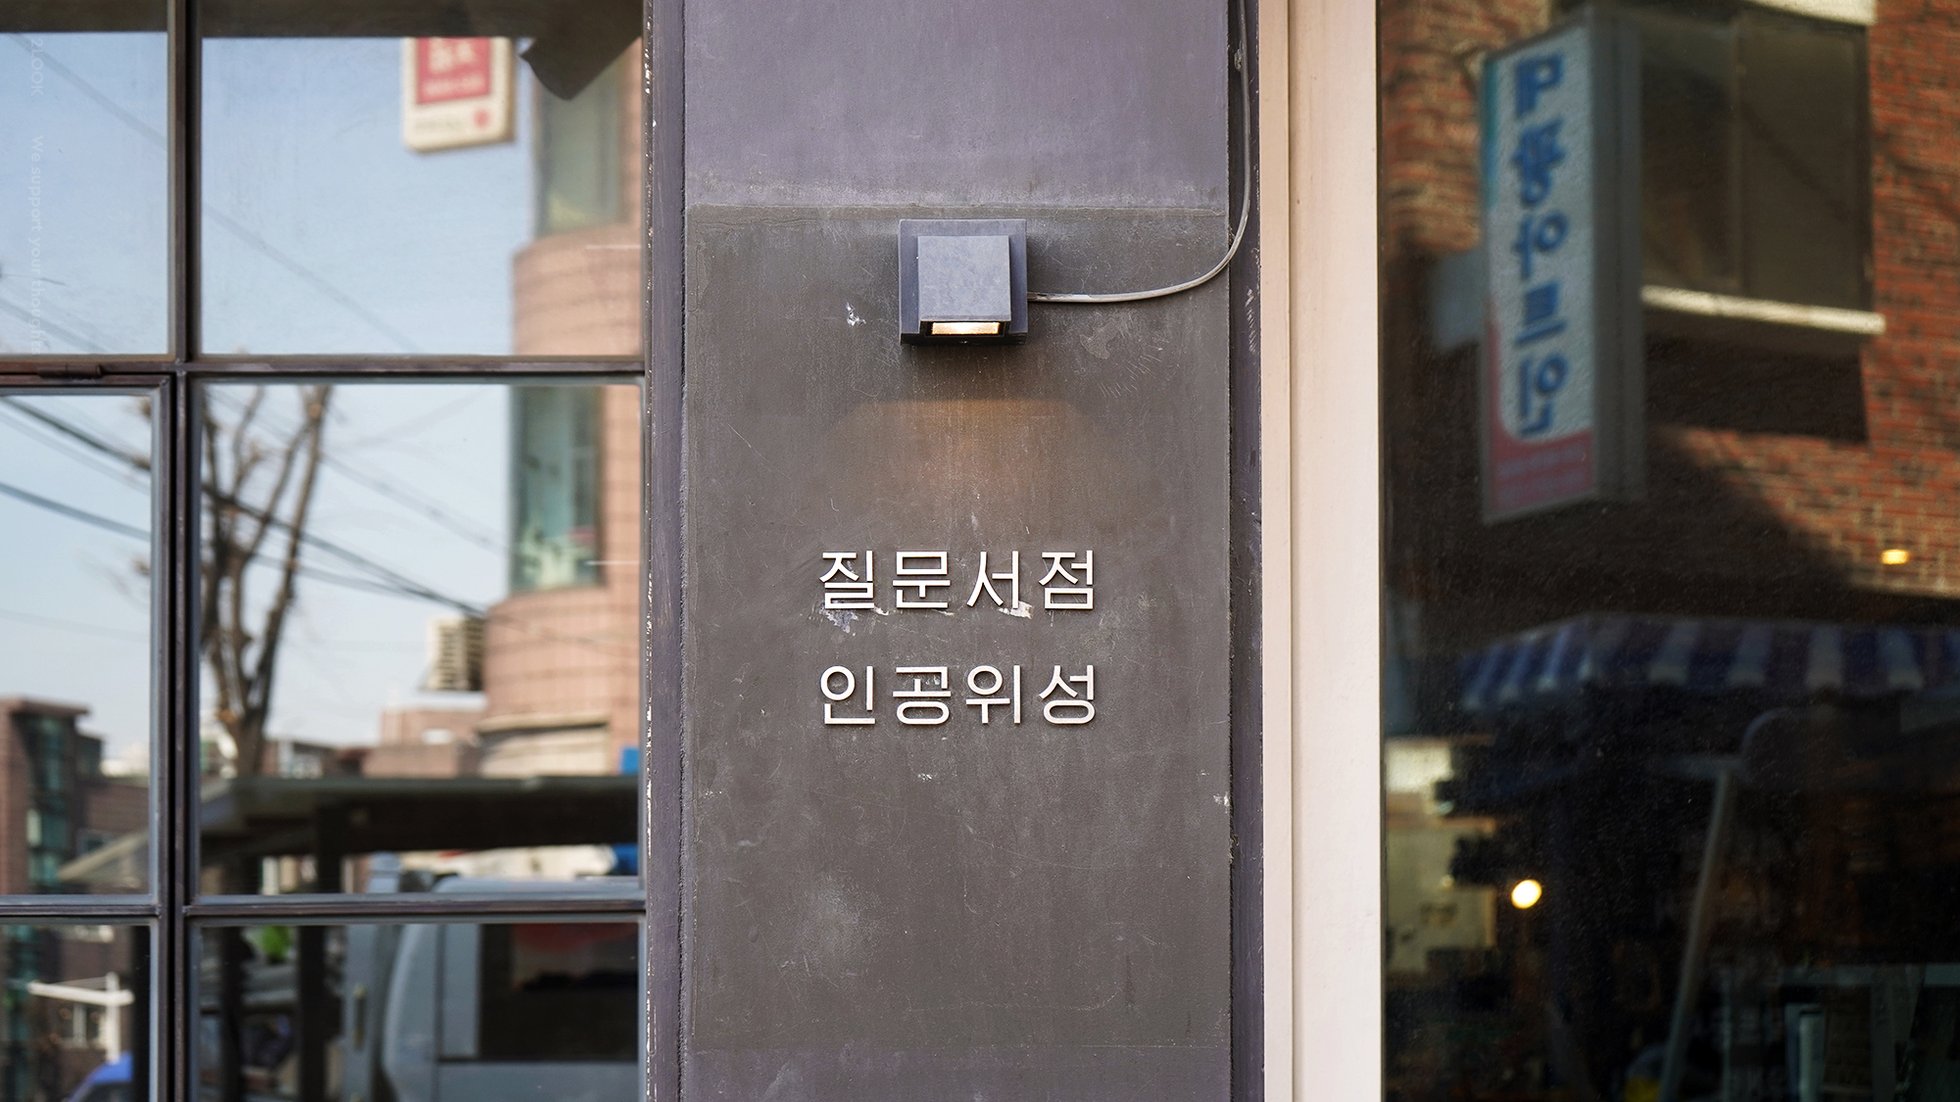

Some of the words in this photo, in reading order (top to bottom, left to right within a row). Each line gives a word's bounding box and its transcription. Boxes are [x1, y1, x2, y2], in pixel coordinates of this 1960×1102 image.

[31, 135, 44, 161] We
[28, 167, 43, 231] support
[28, 237, 41, 274] your
[28, 279, 46, 354] thoughts
[819, 550, 1094, 609] 질문서점
[820, 665, 1096, 725] 인공위성
